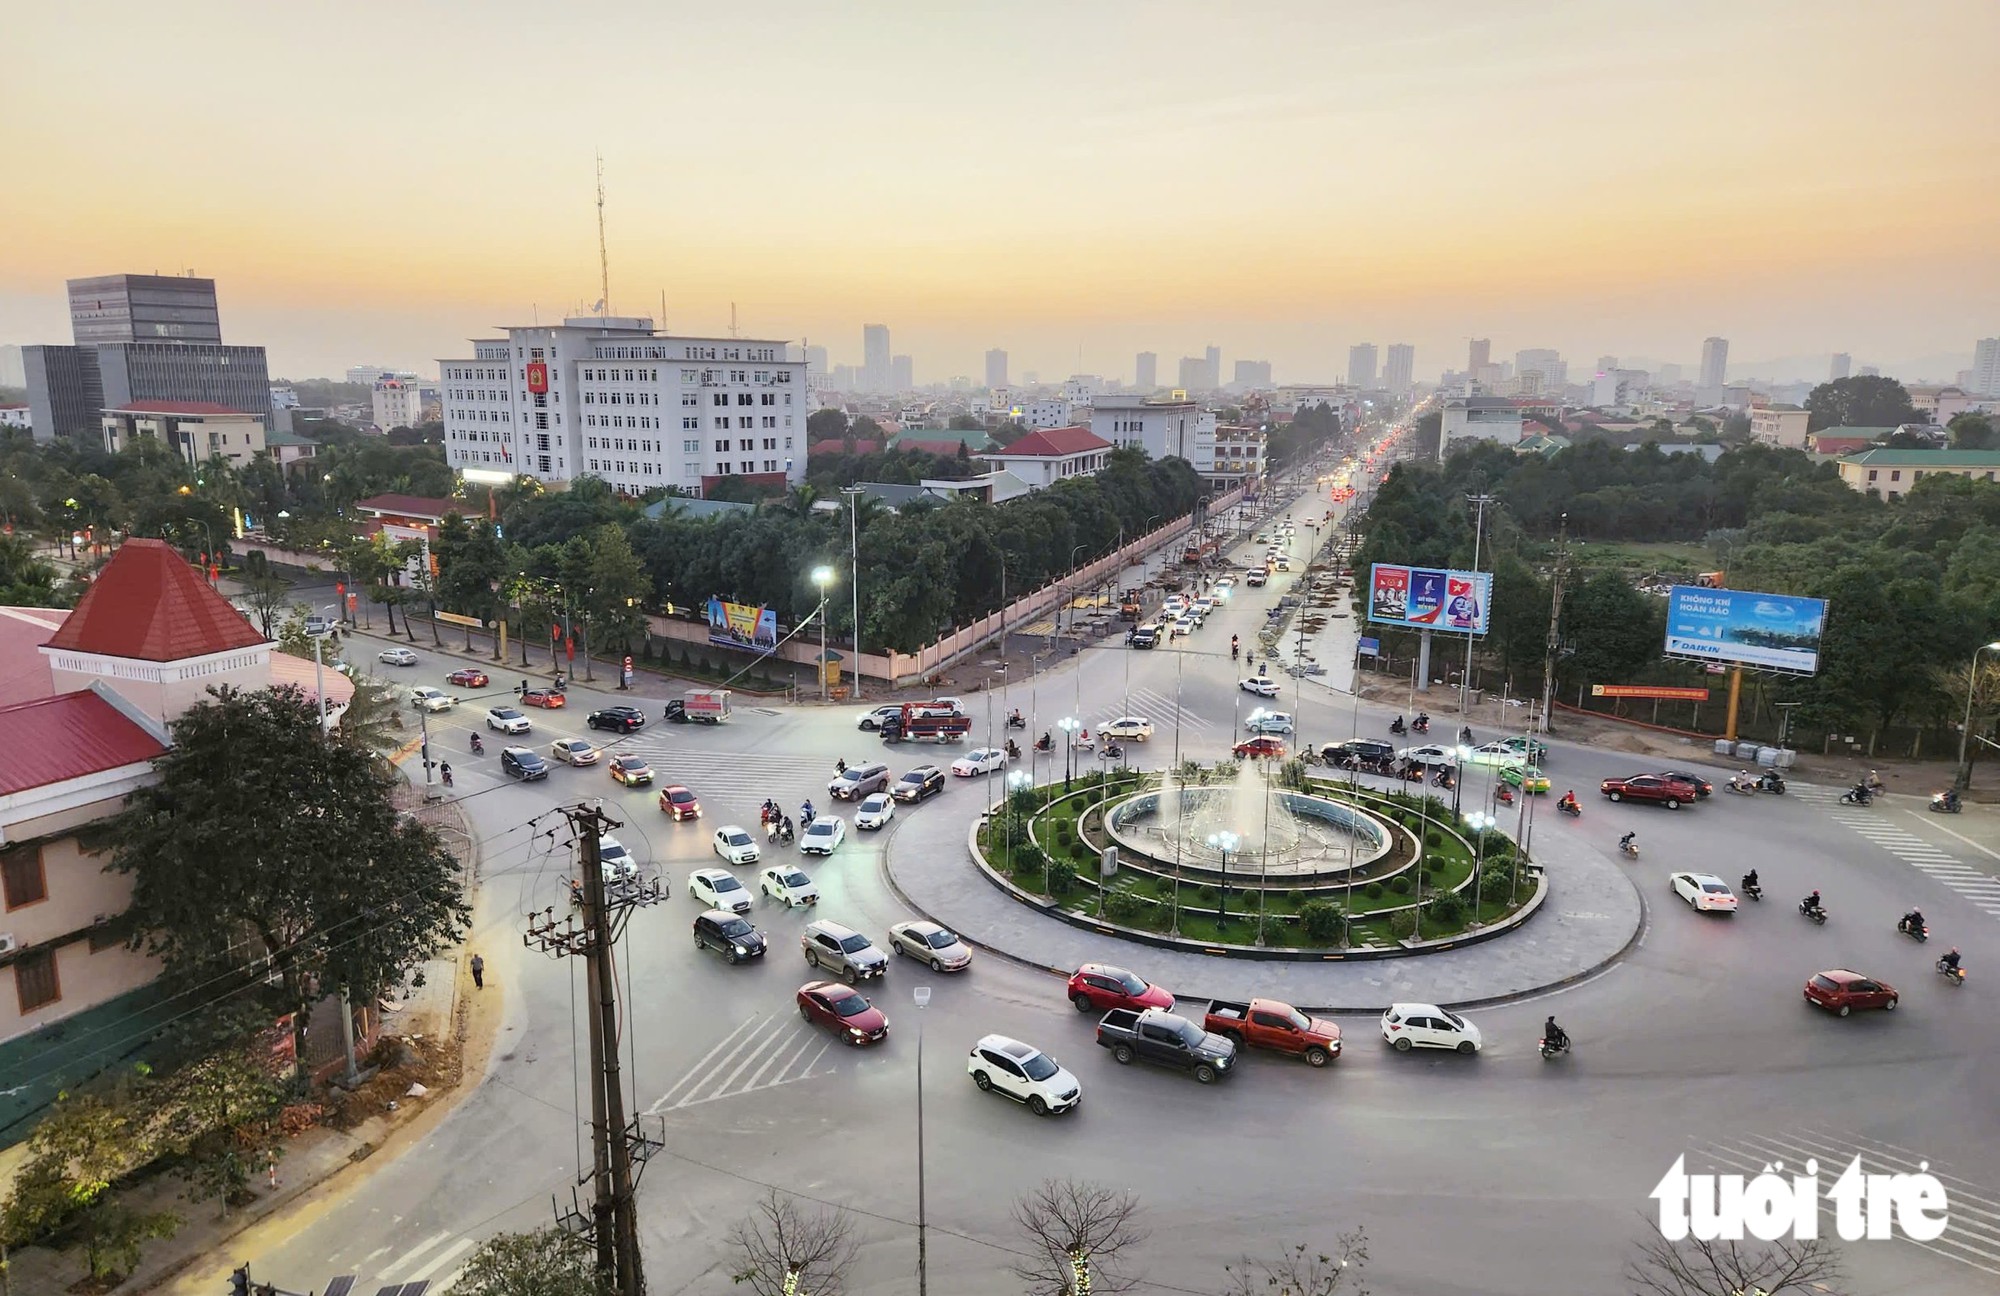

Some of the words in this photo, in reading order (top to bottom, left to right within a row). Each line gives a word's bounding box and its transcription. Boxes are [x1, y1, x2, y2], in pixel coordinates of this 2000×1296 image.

[1680, 594, 1713, 604] KHÔNG
[1715, 597, 1731, 606] KHÍ
[1681, 642, 1720, 653] DAIKIN
